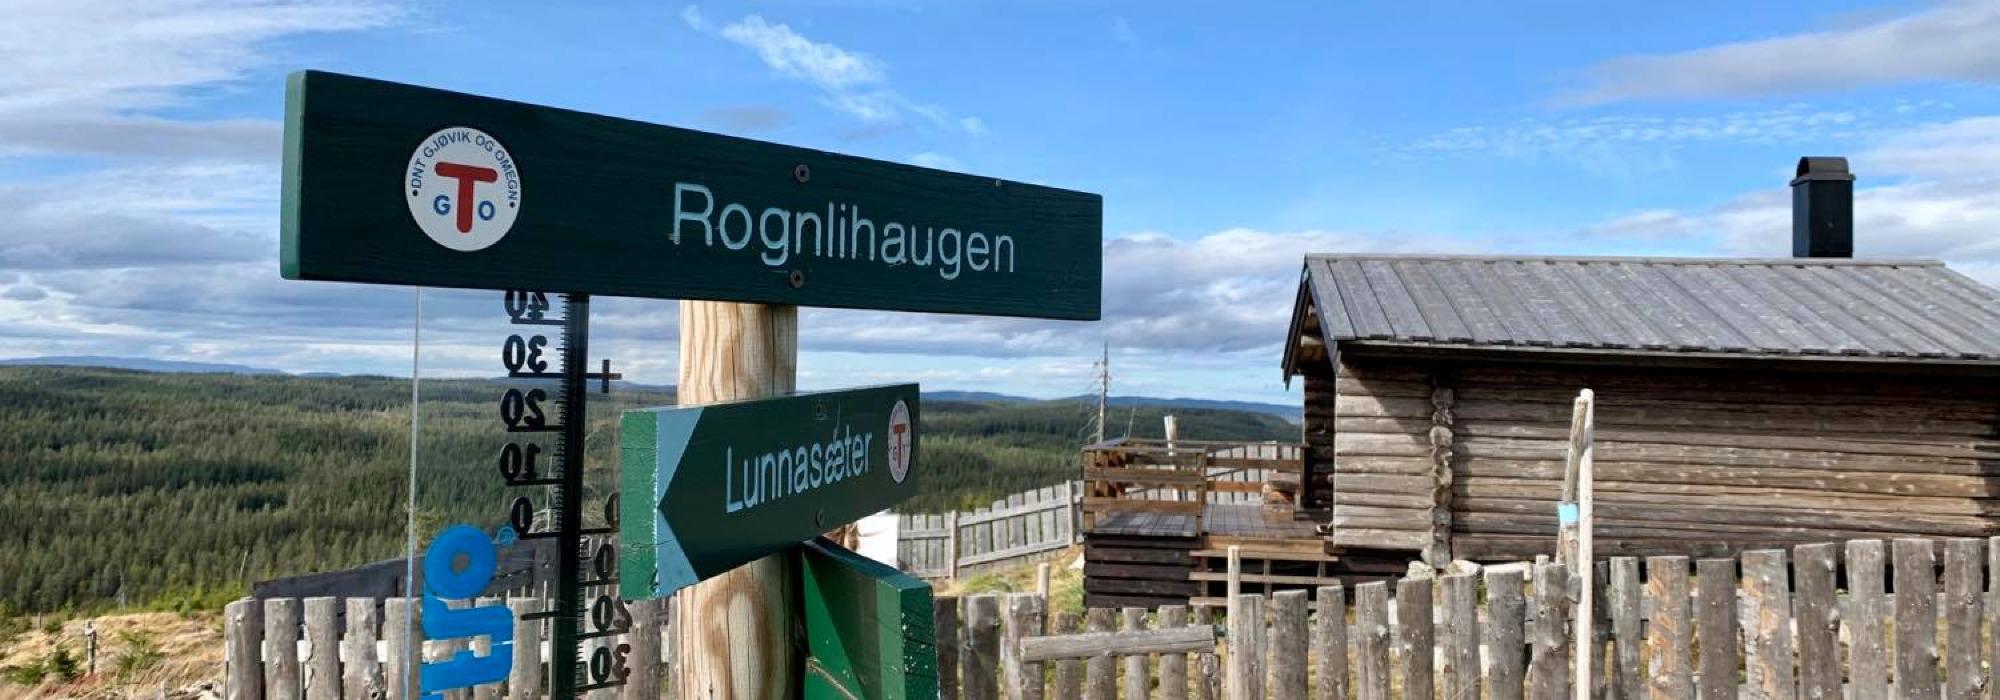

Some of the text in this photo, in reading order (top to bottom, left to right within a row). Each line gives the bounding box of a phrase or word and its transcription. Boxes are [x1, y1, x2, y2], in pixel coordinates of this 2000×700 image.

[411, 131, 518, 200] DNT GJØVIK OG OMEGN
[673, 181, 1014, 280] Rognlihaugen
[726, 424, 873, 513] Lunnasæter
